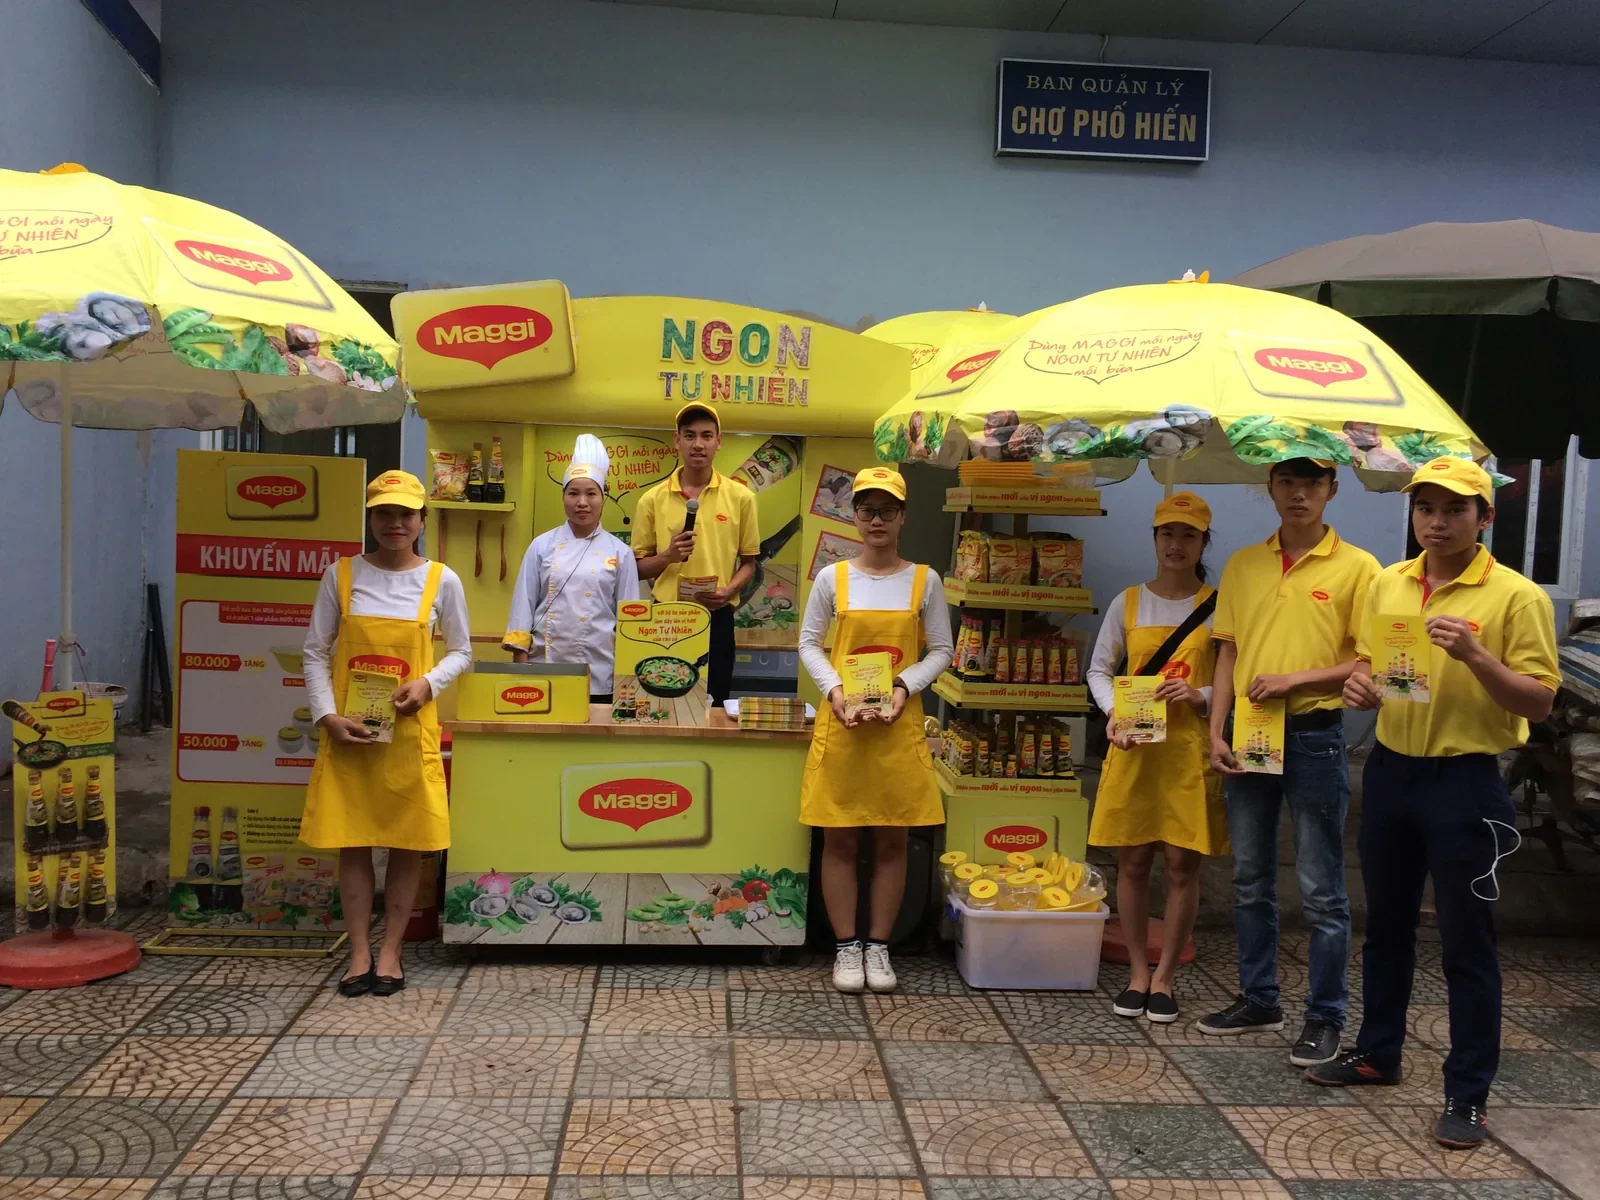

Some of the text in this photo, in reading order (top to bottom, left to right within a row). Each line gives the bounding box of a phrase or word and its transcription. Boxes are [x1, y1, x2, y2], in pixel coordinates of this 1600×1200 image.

[1026, 74, 1184, 96] BAN QUẢN LÝ
[1012, 101, 1197, 143] CHỢ PHỐ HIẾN
[69, 216, 113, 228] ngày
[16, 227, 78, 242] NHIÊN
[188, 246, 281, 275] Maggi
[434, 318, 536, 346] Maggi
[661, 318, 812, 369] NGON
[1028, 340, 1066, 353] Dùng
[1072, 336, 1137, 350] MAGGI
[1167, 332, 1202, 345] ngày
[1046, 353, 1091, 366] NGON
[1122, 346, 1172, 361] NHIÊN
[1266, 354, 1354, 374] Maggi
[710, 368, 809, 406] NHIÊN
[652, 446, 679, 460] ngày
[624, 460, 661, 475] NHIÊN
[246, 484, 298, 496] Maggi
[1001, 492, 1018, 501] mới
[1030, 493, 1039, 502] vị
[1040, 495, 1062, 503] ngon
[200, 542, 291, 572] KHUYẾN
[992, 588, 1009, 597] mới
[1021, 590, 1030, 599] vị
[1031, 592, 1054, 600] ngon
[638, 626, 692, 636] Ngon Tự Nhiên
[184, 655, 230, 668] 80.000
[506, 691, 539, 700] Maggi
[990, 687, 1007, 696] mới
[1018, 689, 1027, 699] vị
[1028, 691, 1050, 699] ngon
[183, 736, 228, 748] 50.000
[981, 782, 998, 791] mới
[1010, 784, 1018, 793] vị
[1019, 785, 1042, 793] ngon
[593, 790, 678, 810] Maggi
[992, 833, 1040, 845] Maggi
